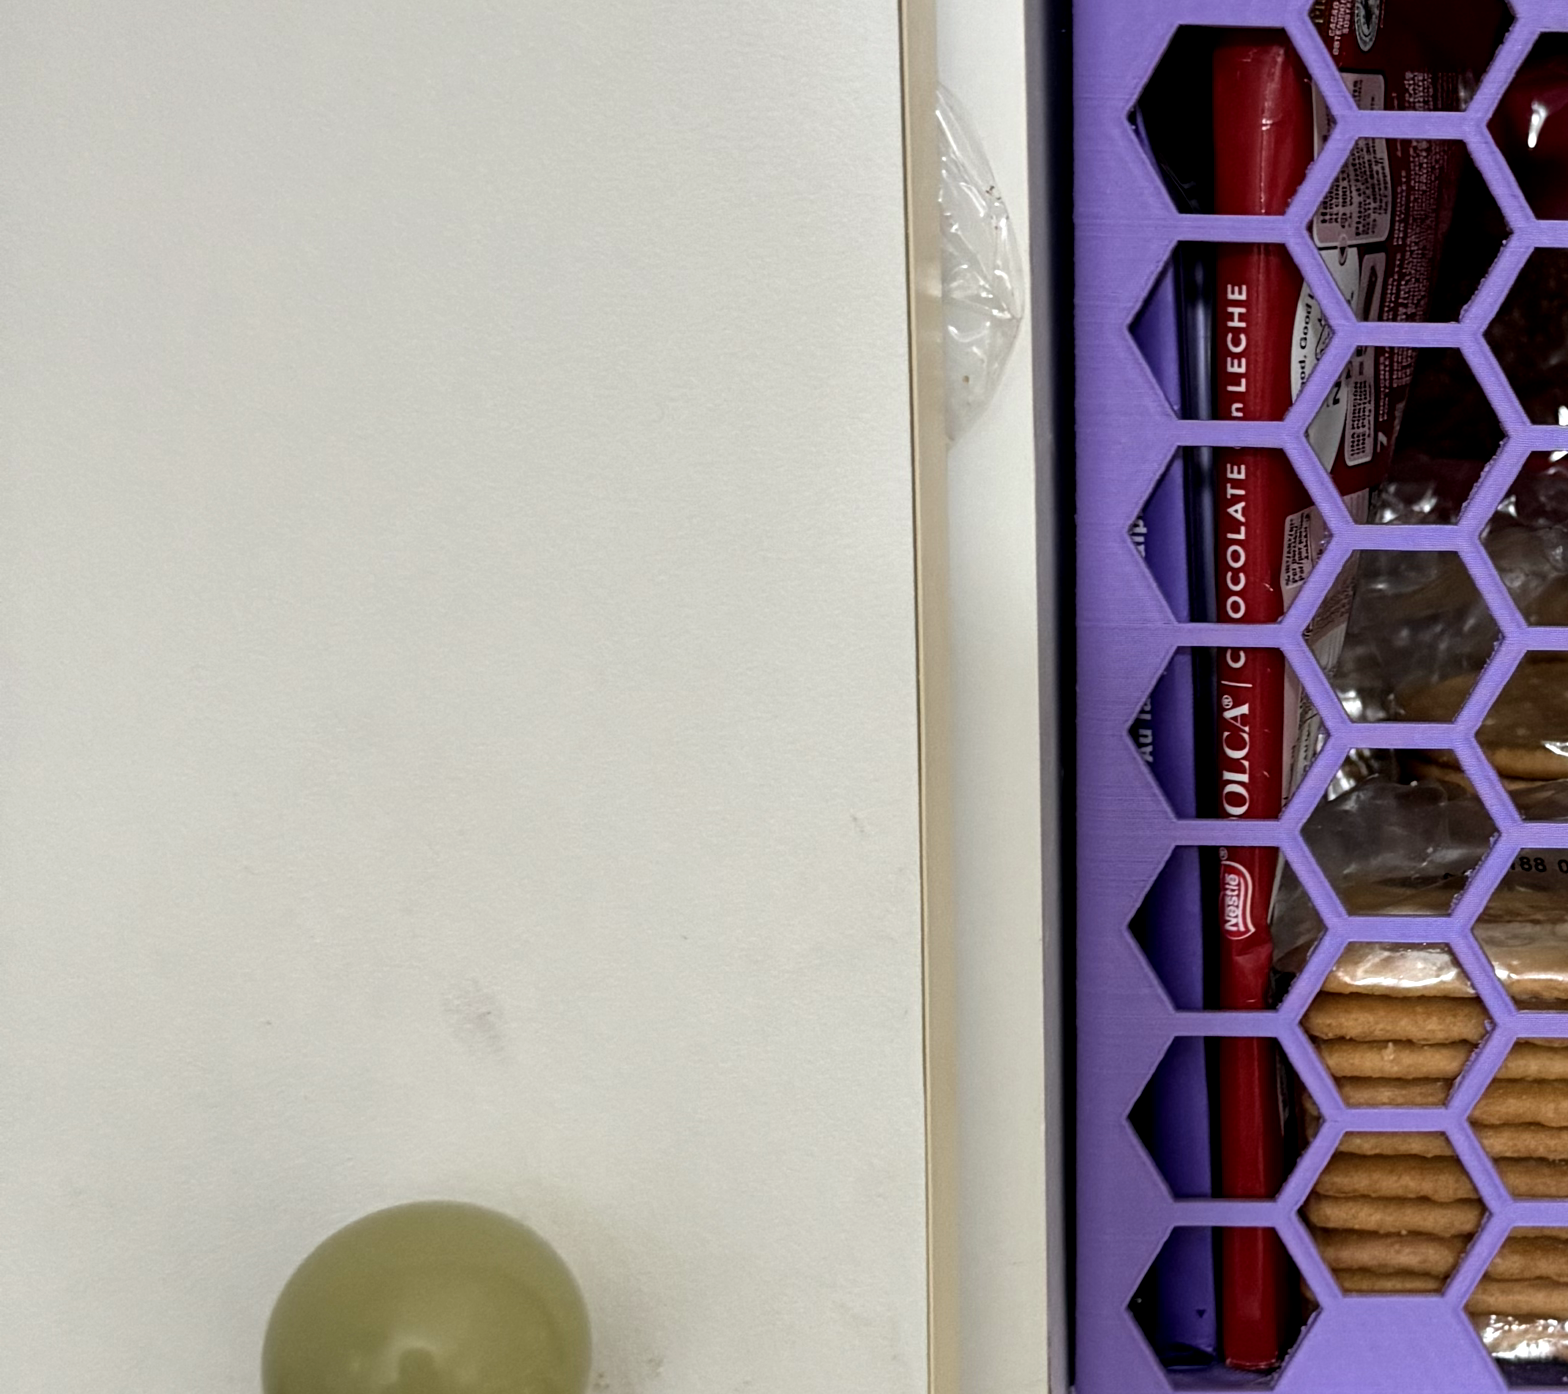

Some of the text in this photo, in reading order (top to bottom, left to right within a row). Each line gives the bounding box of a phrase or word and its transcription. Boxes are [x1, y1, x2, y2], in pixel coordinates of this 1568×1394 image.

[1227, 283, 1247, 394] LECHE
[1299, 303, 1312, 350] Good
[1226, 463, 1248, 669] COCOLATE
